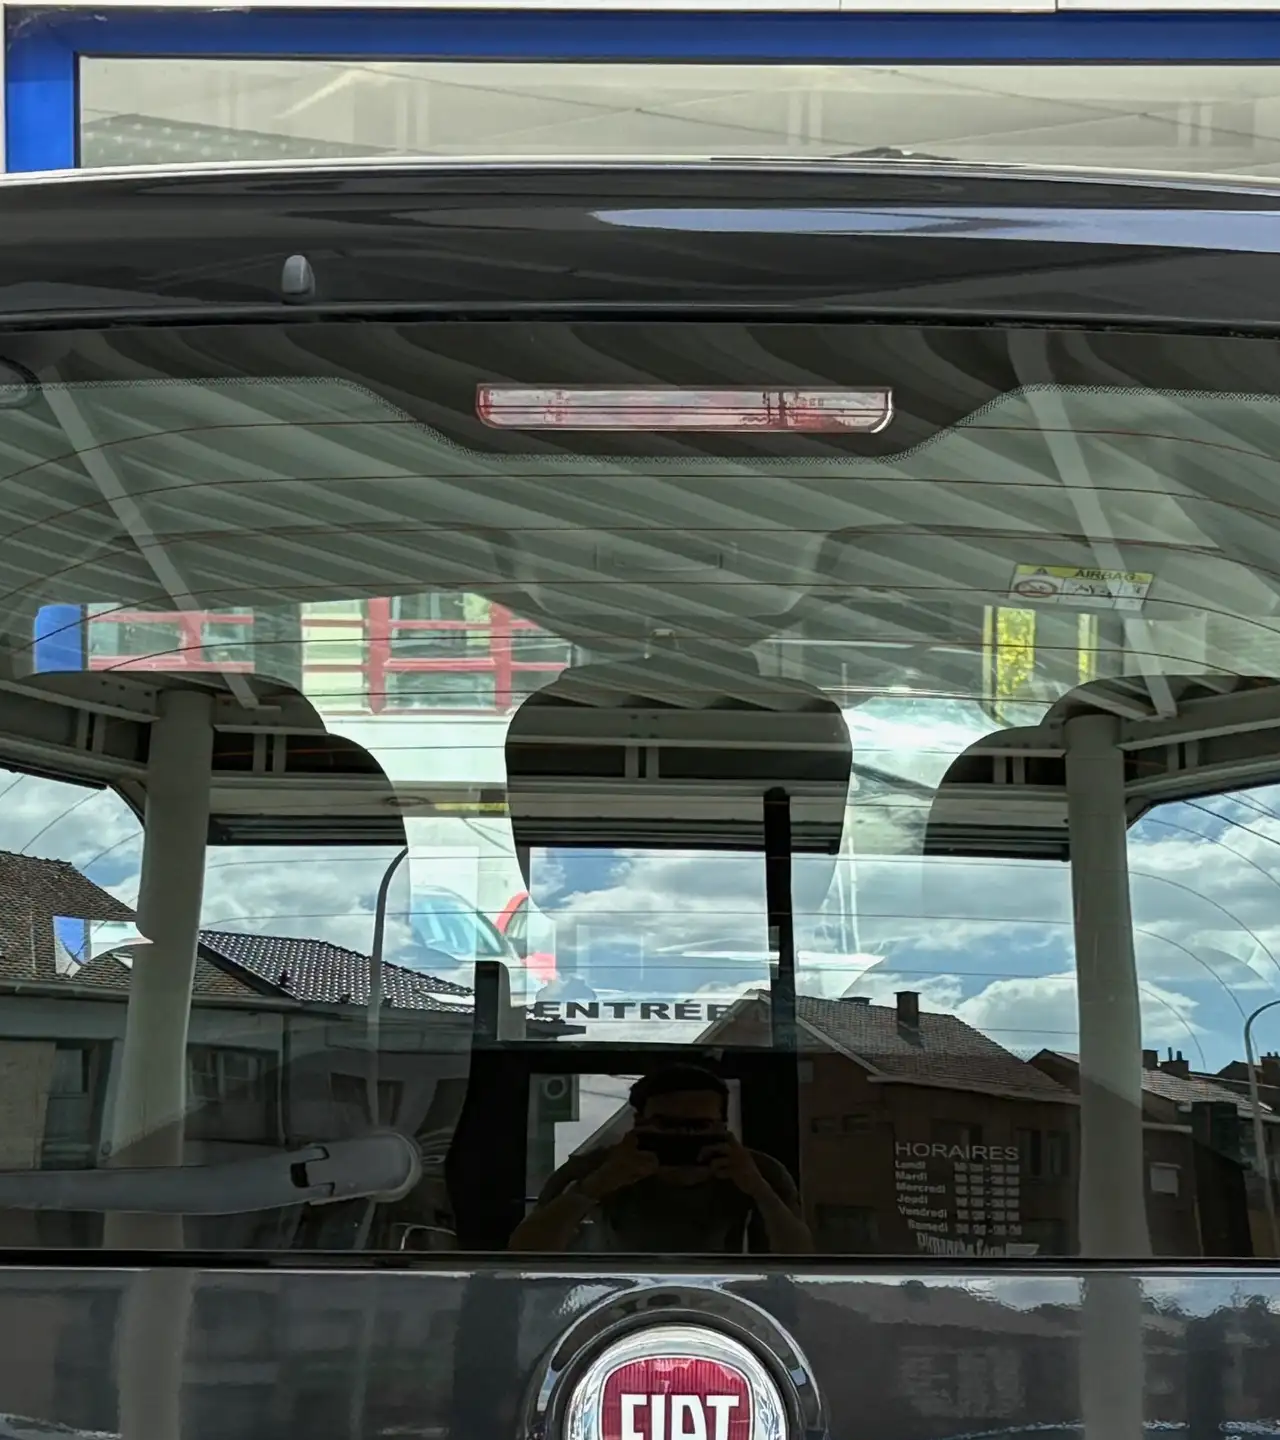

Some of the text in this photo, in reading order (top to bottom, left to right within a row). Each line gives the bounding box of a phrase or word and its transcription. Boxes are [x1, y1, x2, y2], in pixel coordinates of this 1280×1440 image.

[539, 998, 733, 1022] ENTRÉE
[894, 1142, 1019, 1161] HORAIRES
[898, 1205, 948, 1218] Vendredi
